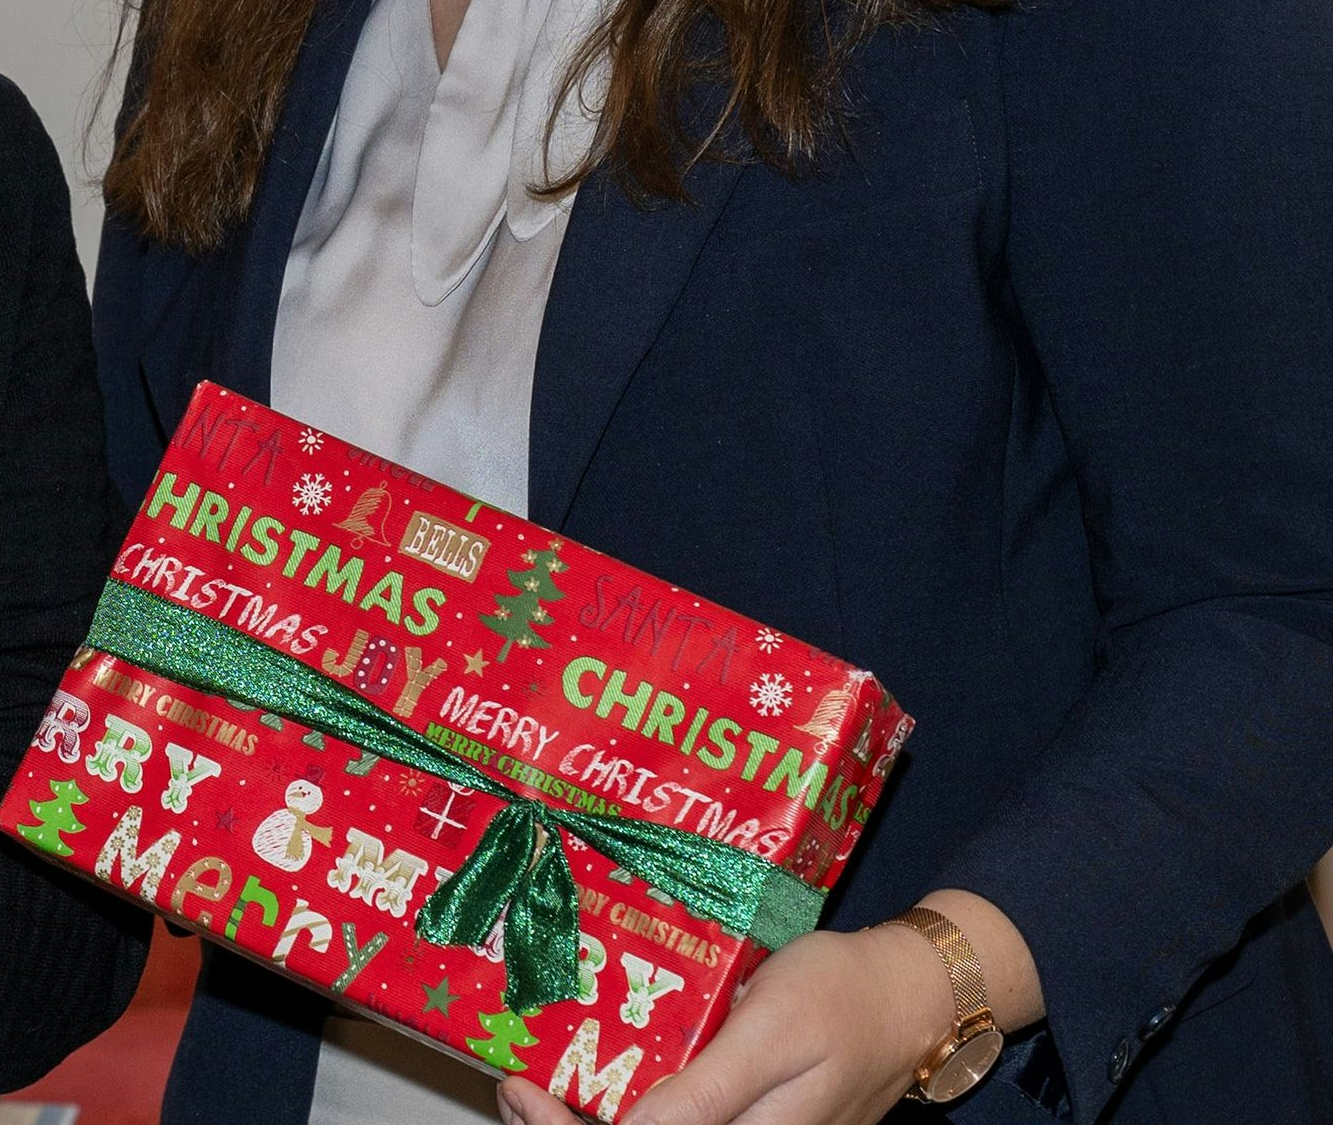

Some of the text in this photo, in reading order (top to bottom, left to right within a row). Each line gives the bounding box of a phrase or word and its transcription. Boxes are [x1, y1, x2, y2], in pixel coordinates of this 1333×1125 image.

[113, 543, 329, 655] CHRISTMAS
[141, 469, 447, 637] HRISTMAS
[404, 516, 484, 577] BELLS
[320, 629, 449, 718] JOY
[579, 575, 740, 684] SANTA
[93, 663, 156, 708] MERRY
[155, 694, 260, 756] CHRISTMAS
[561, 656, 858, 831] CHRISTMAS
[424, 721, 497, 765] MERRY
[497, 753, 622, 816] CHRISTMAS
[439, 685, 560, 761] MERRY
[558, 743, 793, 860] CHRISTMAS
[94, 805, 389, 994] Merry
[609, 902, 721, 968] CHRISTMAS
